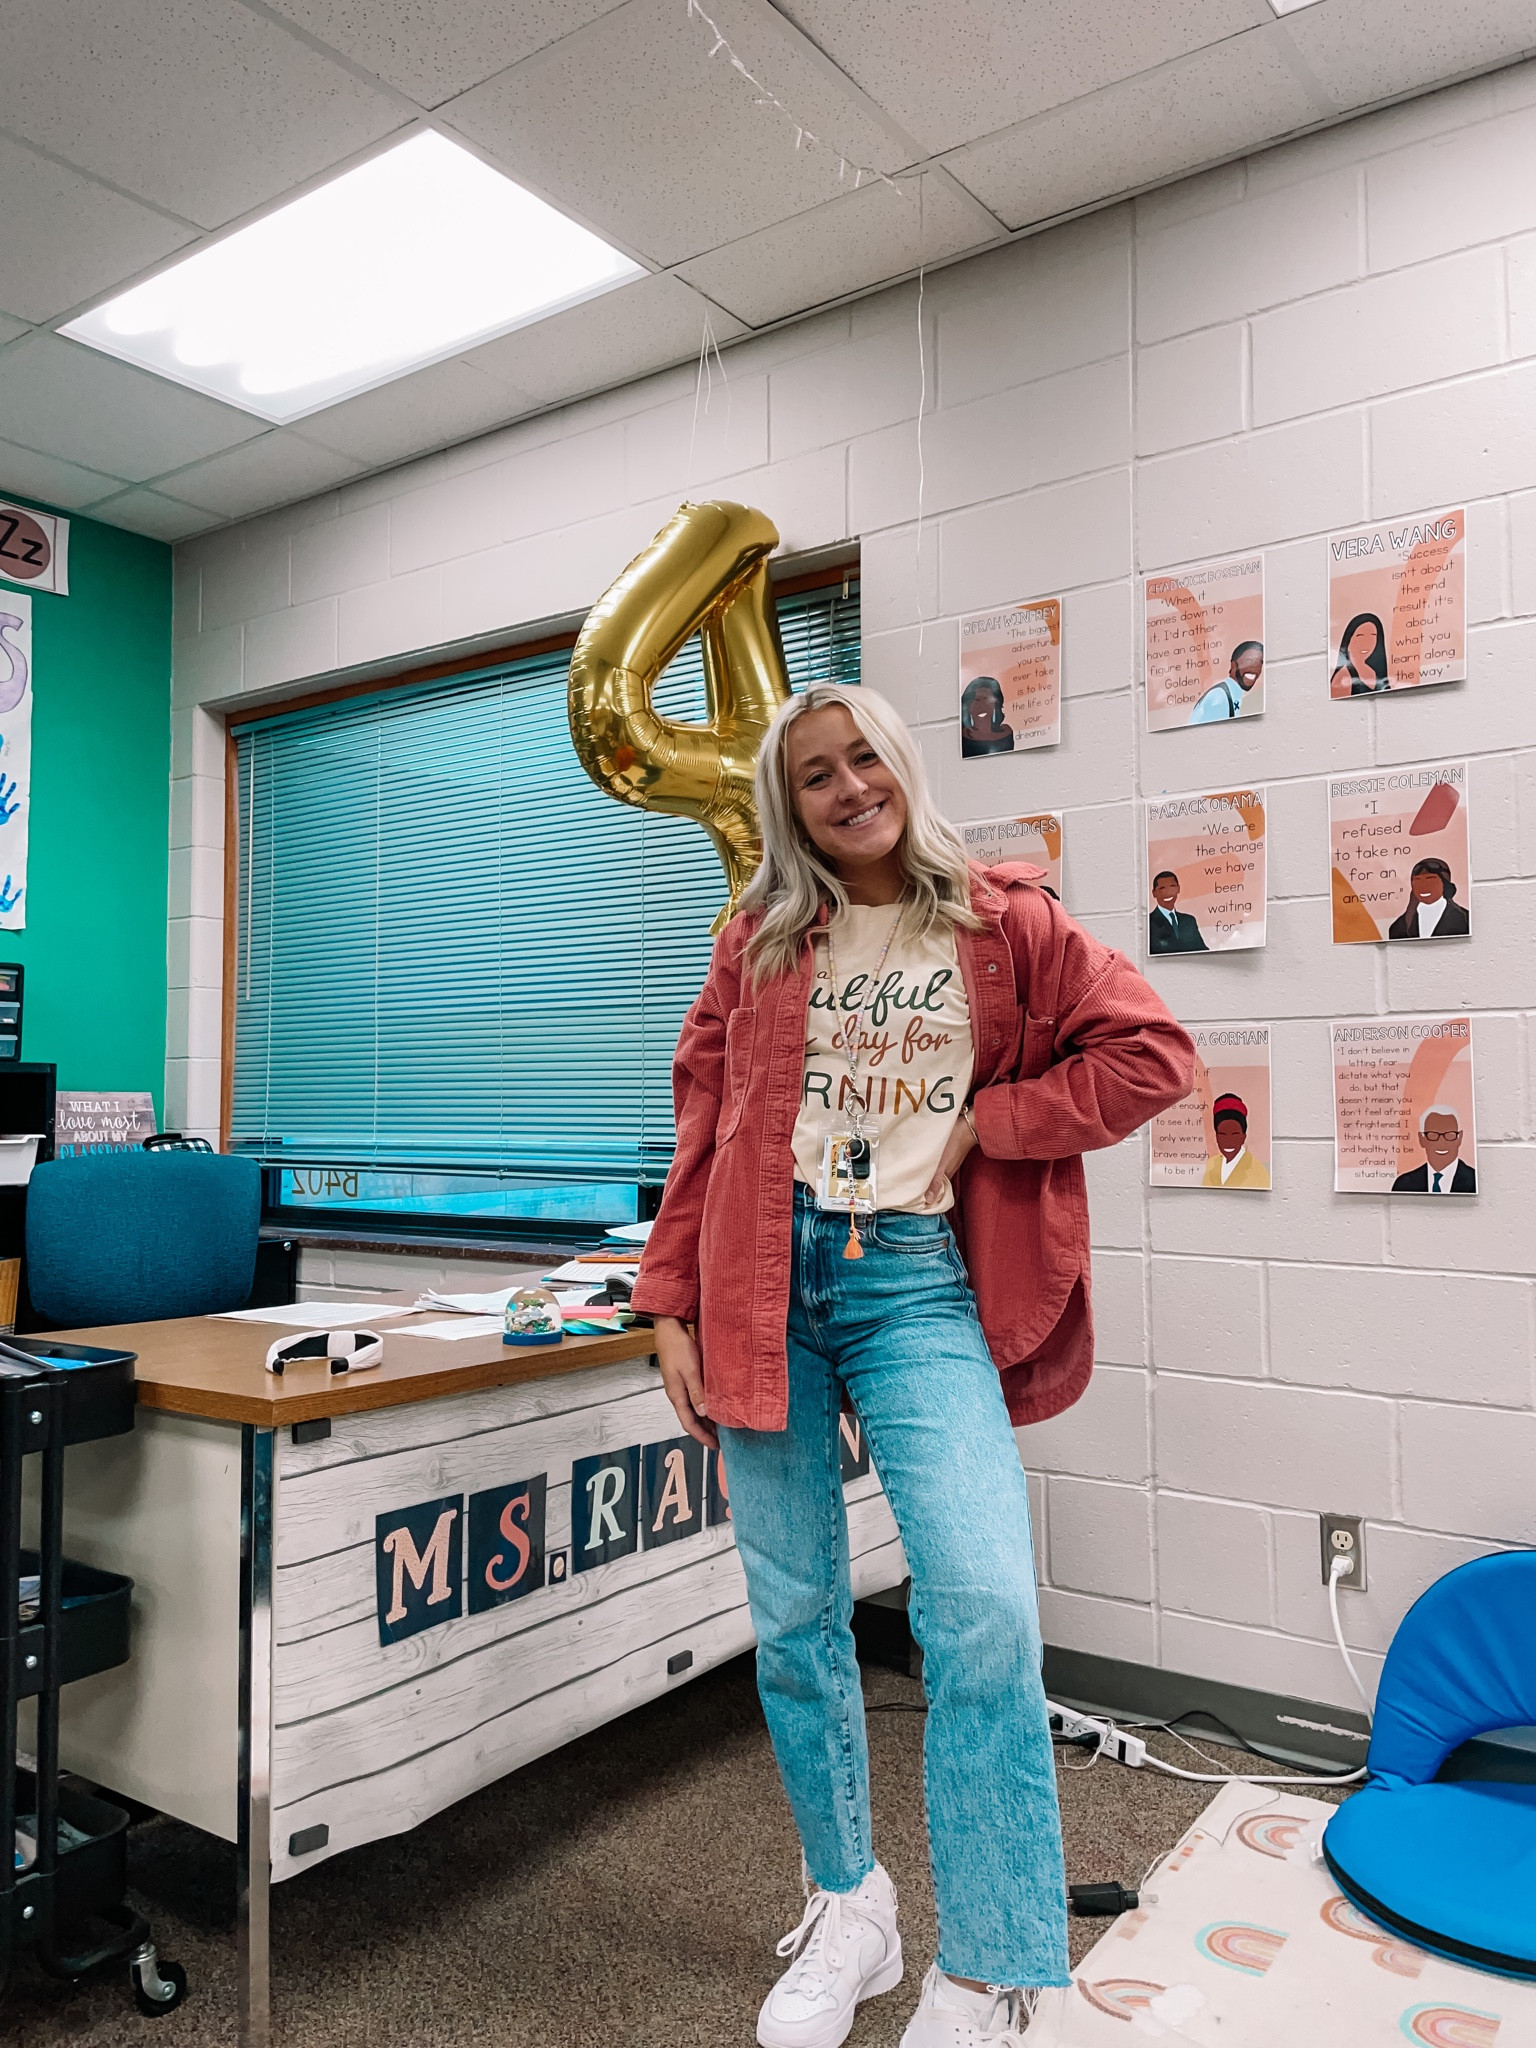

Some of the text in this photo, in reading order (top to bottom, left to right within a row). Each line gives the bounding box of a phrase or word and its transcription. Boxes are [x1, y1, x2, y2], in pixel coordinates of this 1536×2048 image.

[1332, 519, 1456, 561] VERA WANG
[1148, 560, 1261, 595] CHADWICK BOSEMAN
[1392, 560, 1455, 580] isn't about
[1401, 578, 1446, 595] the end
[1198, 590, 1206, 601] it
[1435, 596, 1453, 607] it's
[963, 605, 1057, 636] OPRAH WINFREY
[1146, 604, 1224, 630] comes down to
[1405, 614, 1439, 628] about
[1029, 622, 1060, 637] biggest
[1164, 627, 1179, 641] I'd
[1182, 624, 1218, 637] rather
[1012, 638, 1056, 654] adventure
[1395, 632, 1451, 647] what you
[1146, 640, 1222, 661] have an action
[1391, 648, 1456, 665] learn along
[1017, 654, 1050, 668] you can
[1150, 657, 1220, 678] figure than a
[1013, 667, 1054, 683] ever take
[1164, 675, 1200, 690] Golden
[1396, 669, 1415, 681] the
[1017, 682, 1052, 697] is to live
[1012, 694, 1056, 712] the life of
[1023, 715, 1042, 726] your
[1331, 767, 1464, 798] BESSIE COLEMAN
[1150, 791, 1263, 821] BARACK OBAMA
[965, 818, 1057, 844] RUBY BRIDGES
[1233, 823, 1256, 833] are
[1342, 820, 1402, 839] refused
[1195, 840, 1264, 857] the change
[1334, 845, 1411, 862] to take no
[1204, 861, 1255, 876] we have
[1349, 867, 1397, 882] for an
[1214, 882, 1244, 894] been
[1208, 900, 1252, 914] waiting
[808, 969, 953, 1027] utful
[901, 1015, 953, 1064] for
[1209, 1030, 1269, 1046] GORMAN
[1334, 1023, 1468, 1042] ANDERSON COOPER
[832, 1014, 898, 1067] day
[1348, 1046, 1368, 1055] don't
[1371, 1046, 1400, 1055] believe
[1348, 1057, 1398, 1068] letting fear
[1338, 1070, 1411, 1080] dictate what you
[804, 1071, 955, 1115] RNING
[1364, 1083, 1378, 1092] but
[1382, 1083, 1399, 1091] that
[69, 1101, 120, 1112] WHAT I
[1179, 1101, 1209, 1112] enough
[1338, 1095, 1368, 1104] doesn't
[1396, 1096, 1413, 1105] you
[1340, 1107, 1411, 1116] don't feel afraid
[57, 1109, 141, 1130] love most
[1156, 1117, 1165, 1126] to
[1196, 1117, 1204, 1126] if
[1343, 1121, 1353, 1129] or
[1404, 1120, 1409, 1128] I
[73, 1130, 128, 1142] ABOUT MY
[1159, 1134, 1204, 1144] only we're
[1344, 1131, 1411, 1141] think it's normal
[1153, 1149, 1210, 1161] brave enough
[1340, 1145, 1414, 1155] and healthy to be
[1359, 1157, 1386, 1166] afraid
[1164, 1166, 1173, 1175] to
[1175, 1166, 1186, 1175] be
[383, 1491, 564, 1624] MS.
